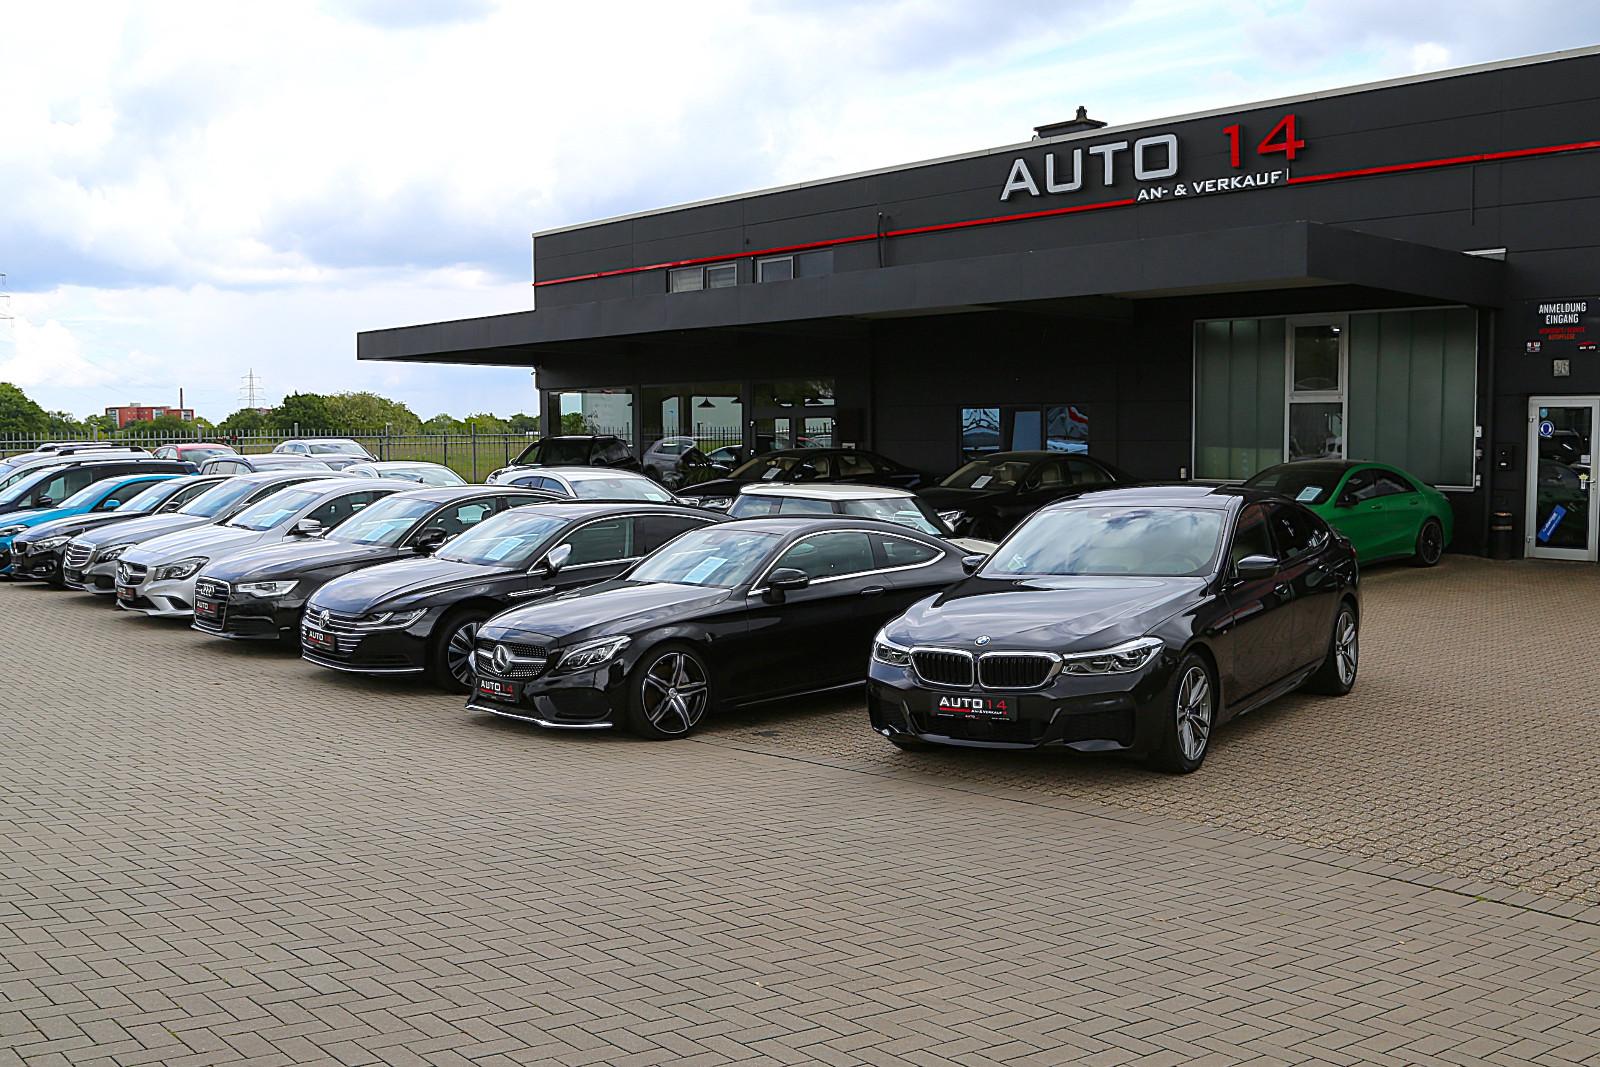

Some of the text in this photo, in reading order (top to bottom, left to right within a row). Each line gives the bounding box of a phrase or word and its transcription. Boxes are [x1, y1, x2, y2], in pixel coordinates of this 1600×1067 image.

[1000, 114, 1305, 201] AUTO 14
[1137, 170, 1283, 201] AN- & VERKAUF
[1539, 302, 1587, 314] ANMELDUNG
[1545, 314, 1579, 325] EINGANG
[196, 601, 209, 610] AUTO
[309, 630, 324, 641] AUTO
[480, 680, 501, 691] AUTO
[939, 696, 1008, 710] AUTO 14
